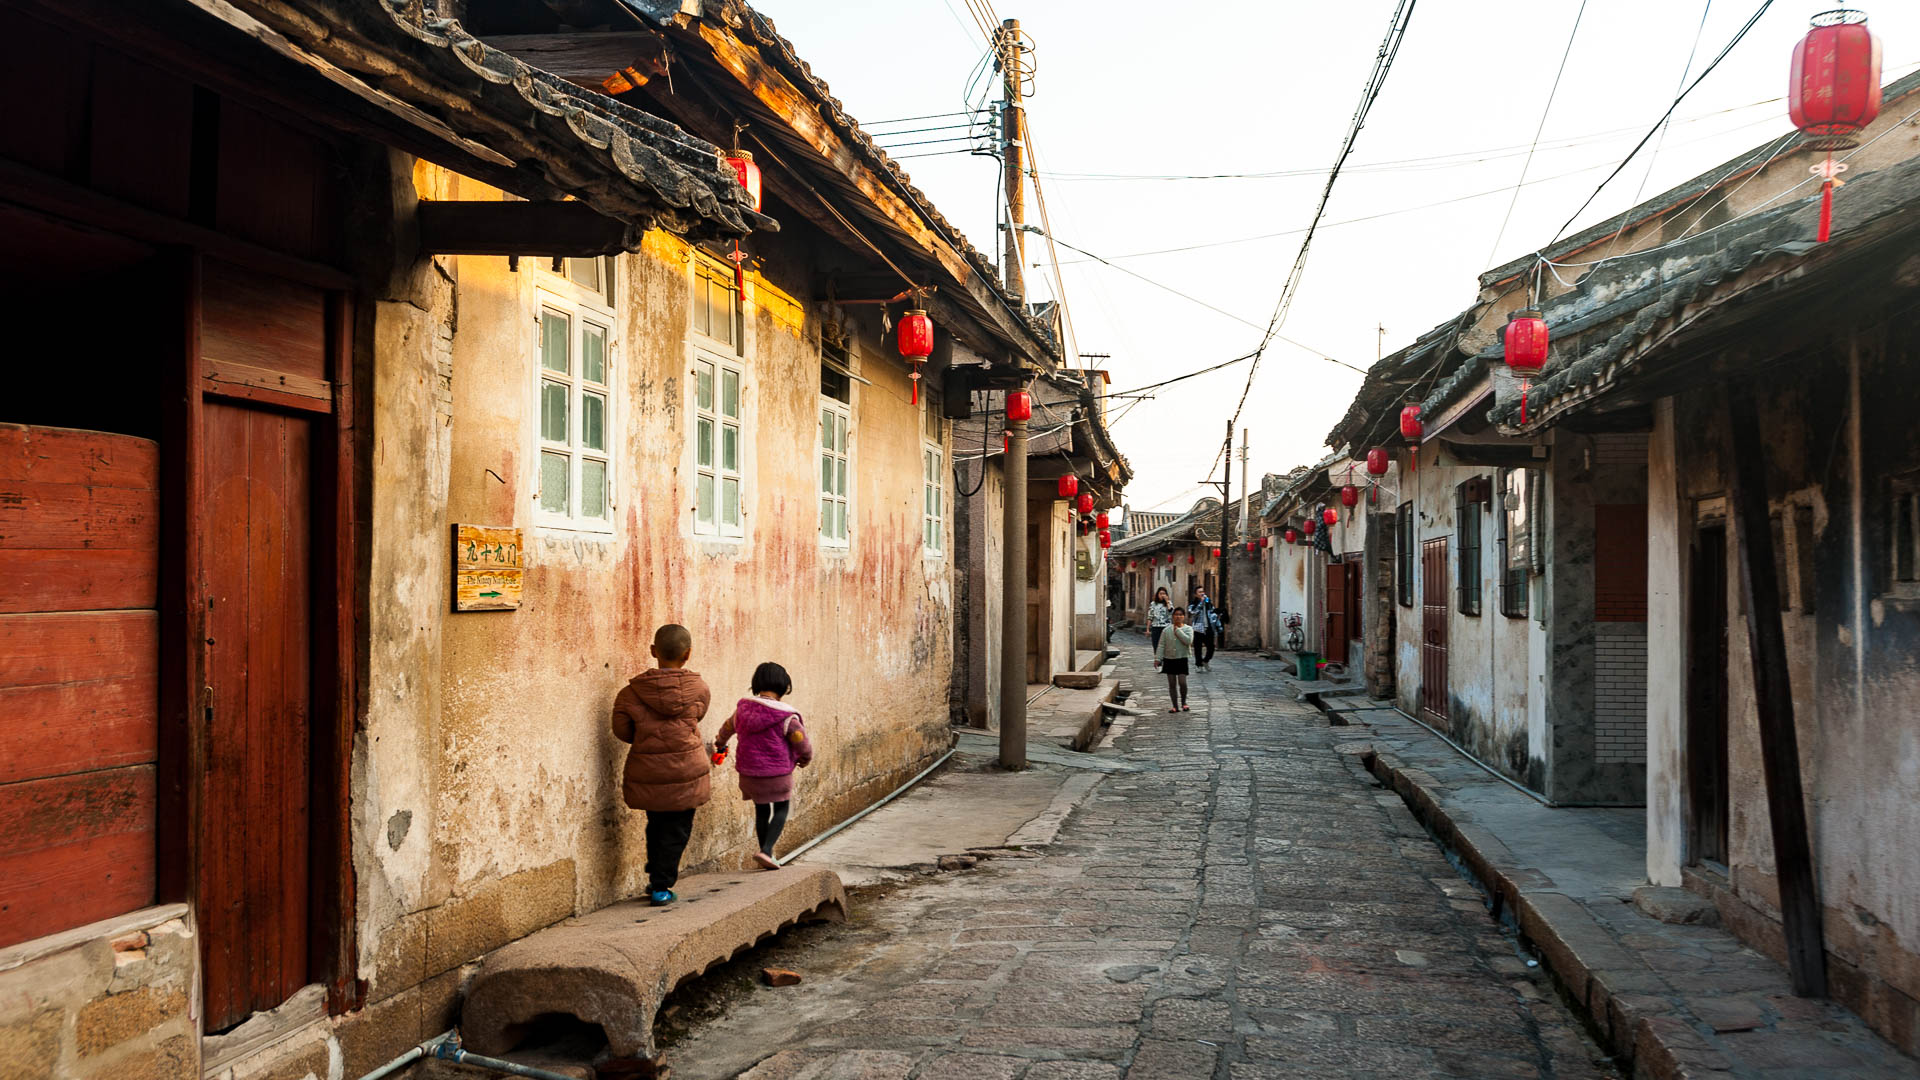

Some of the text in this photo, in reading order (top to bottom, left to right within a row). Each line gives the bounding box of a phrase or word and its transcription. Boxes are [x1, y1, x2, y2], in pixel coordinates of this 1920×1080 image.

[467, 540, 516, 567] 九十九门
[466, 576, 476, 585] The
